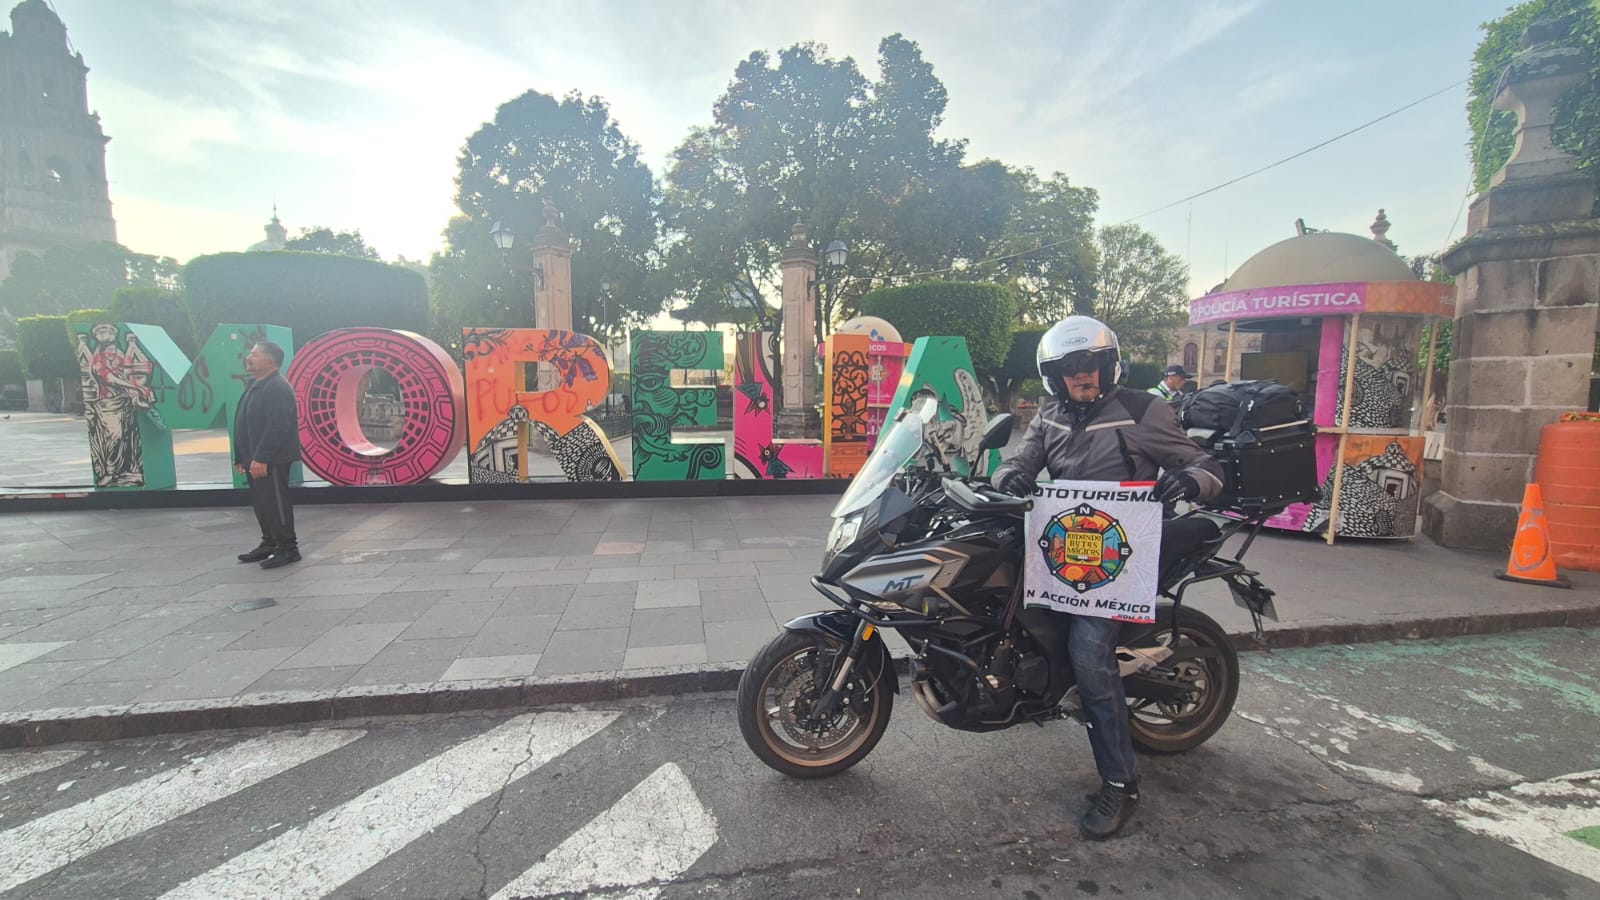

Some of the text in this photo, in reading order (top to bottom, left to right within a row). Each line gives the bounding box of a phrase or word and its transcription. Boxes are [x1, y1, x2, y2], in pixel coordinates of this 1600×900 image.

[1199, 291, 1361, 317] POLICÍA TURÍSTICA
[1031, 487, 1159, 503] OTOTURISMO
[1079, 507, 1090, 515] N
[882, 574, 925, 593] MT
[1026, 589, 1151, 613] N ACCIÓN MÉXICO
